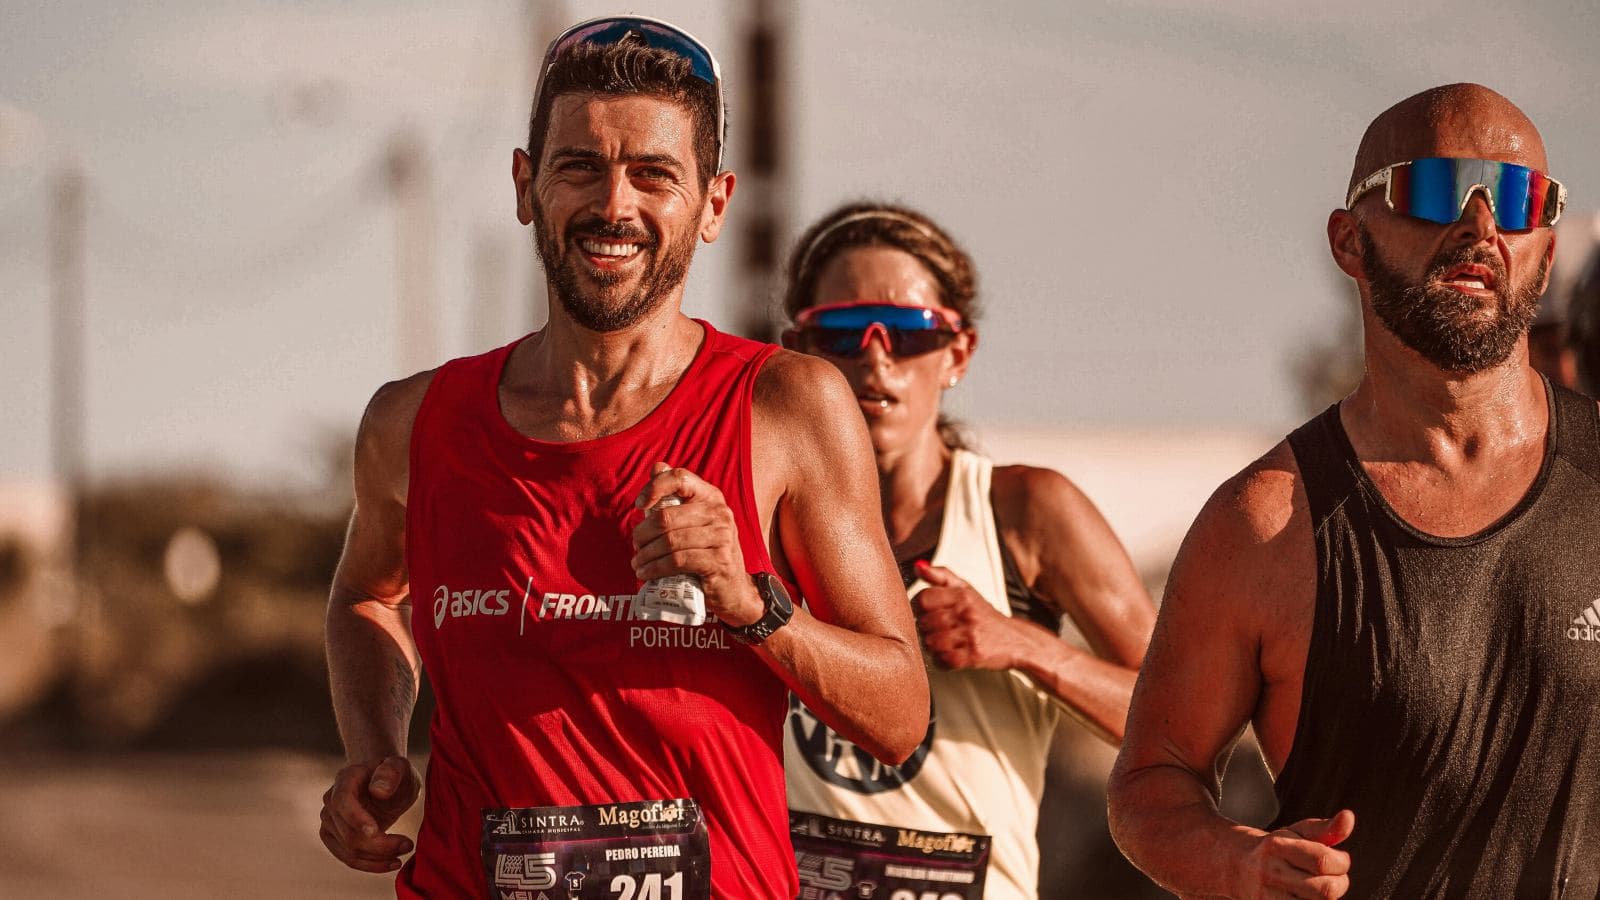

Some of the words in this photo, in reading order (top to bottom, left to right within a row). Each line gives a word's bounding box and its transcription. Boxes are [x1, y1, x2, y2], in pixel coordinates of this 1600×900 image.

[629, 626, 730, 650] PORTUGAL
[521, 815, 580, 828] SINTRA
[605, 847, 638, 861] PEDRO
[640, 845, 681, 859] PEREIRA
[610, 871, 683, 900] 241
